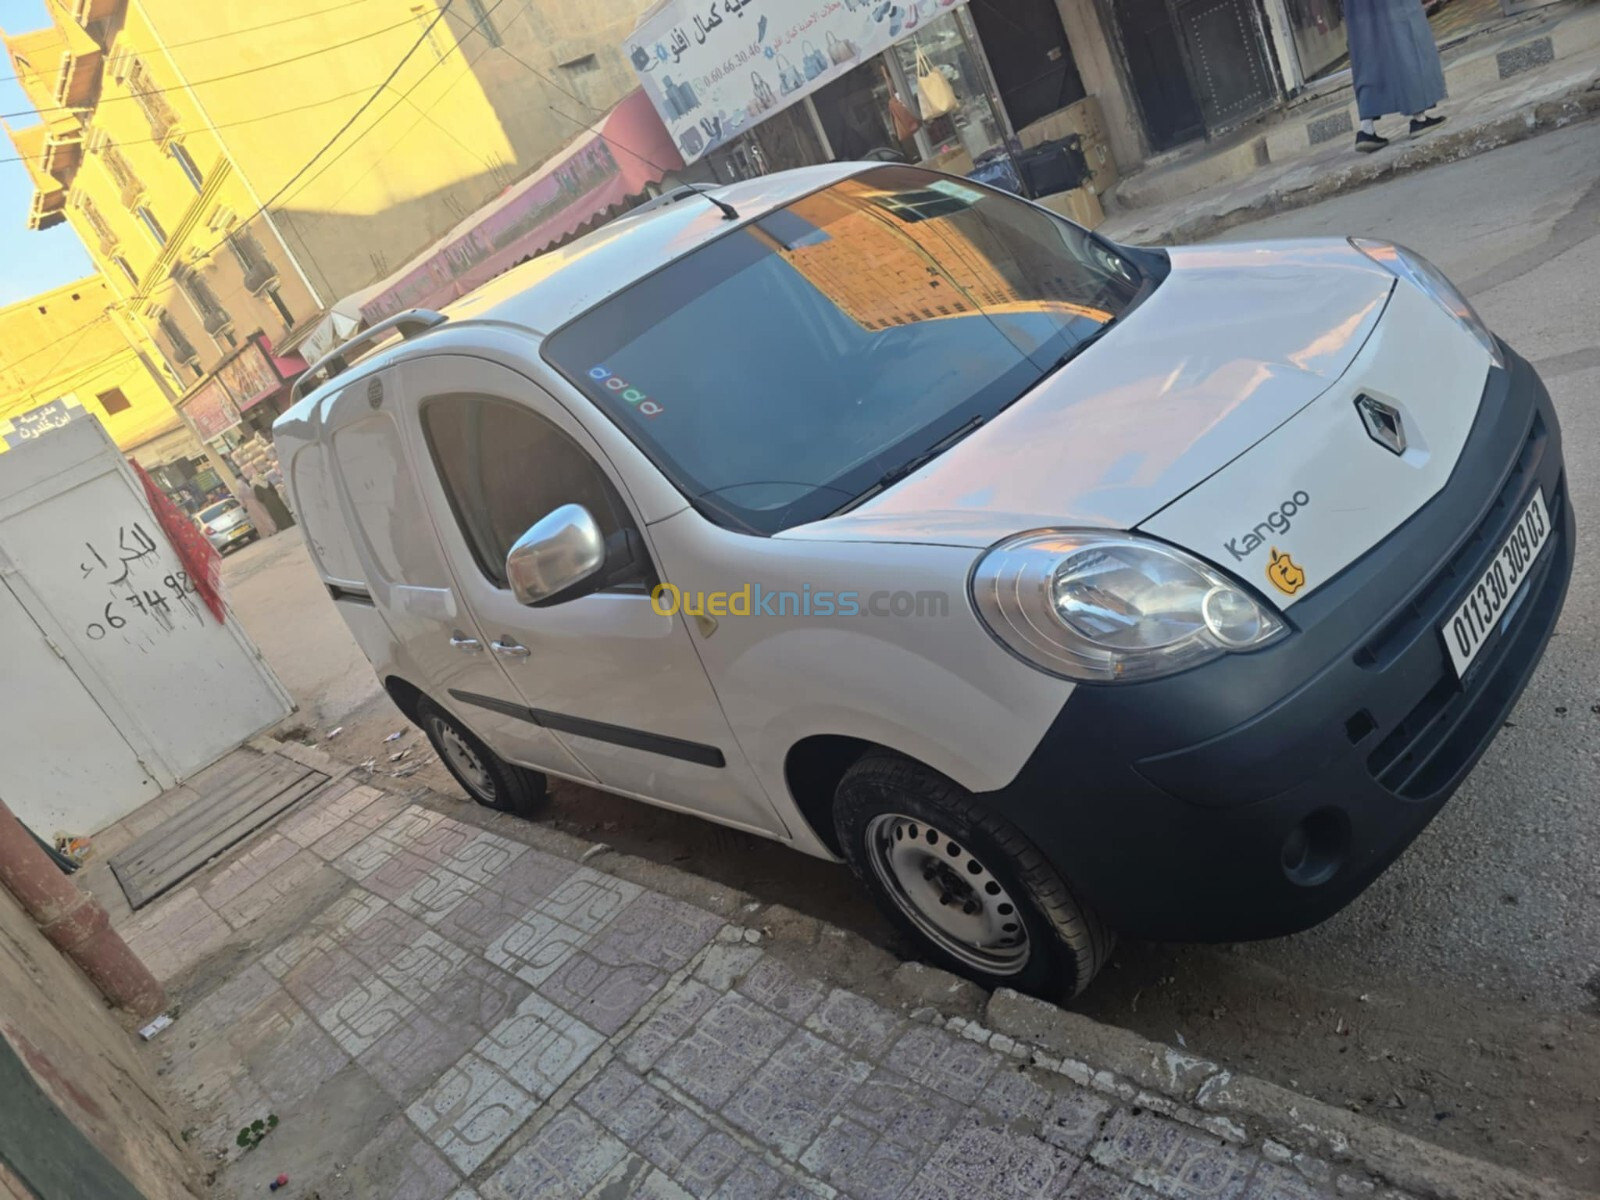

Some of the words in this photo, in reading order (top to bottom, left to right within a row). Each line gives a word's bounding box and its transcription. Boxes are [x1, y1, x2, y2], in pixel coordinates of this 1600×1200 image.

[693, 2, 723, 45] كمال
[671, 28, 692, 64] افلو
[19, 419, 56, 439] خلدون
[55, 411, 72, 428] ابن
[1223, 490, 1310, 562] Kangoo
[1453, 559, 1509, 659] 011330
[1502, 523, 1531, 585] 309
[1525, 499, 1545, 548] 03
